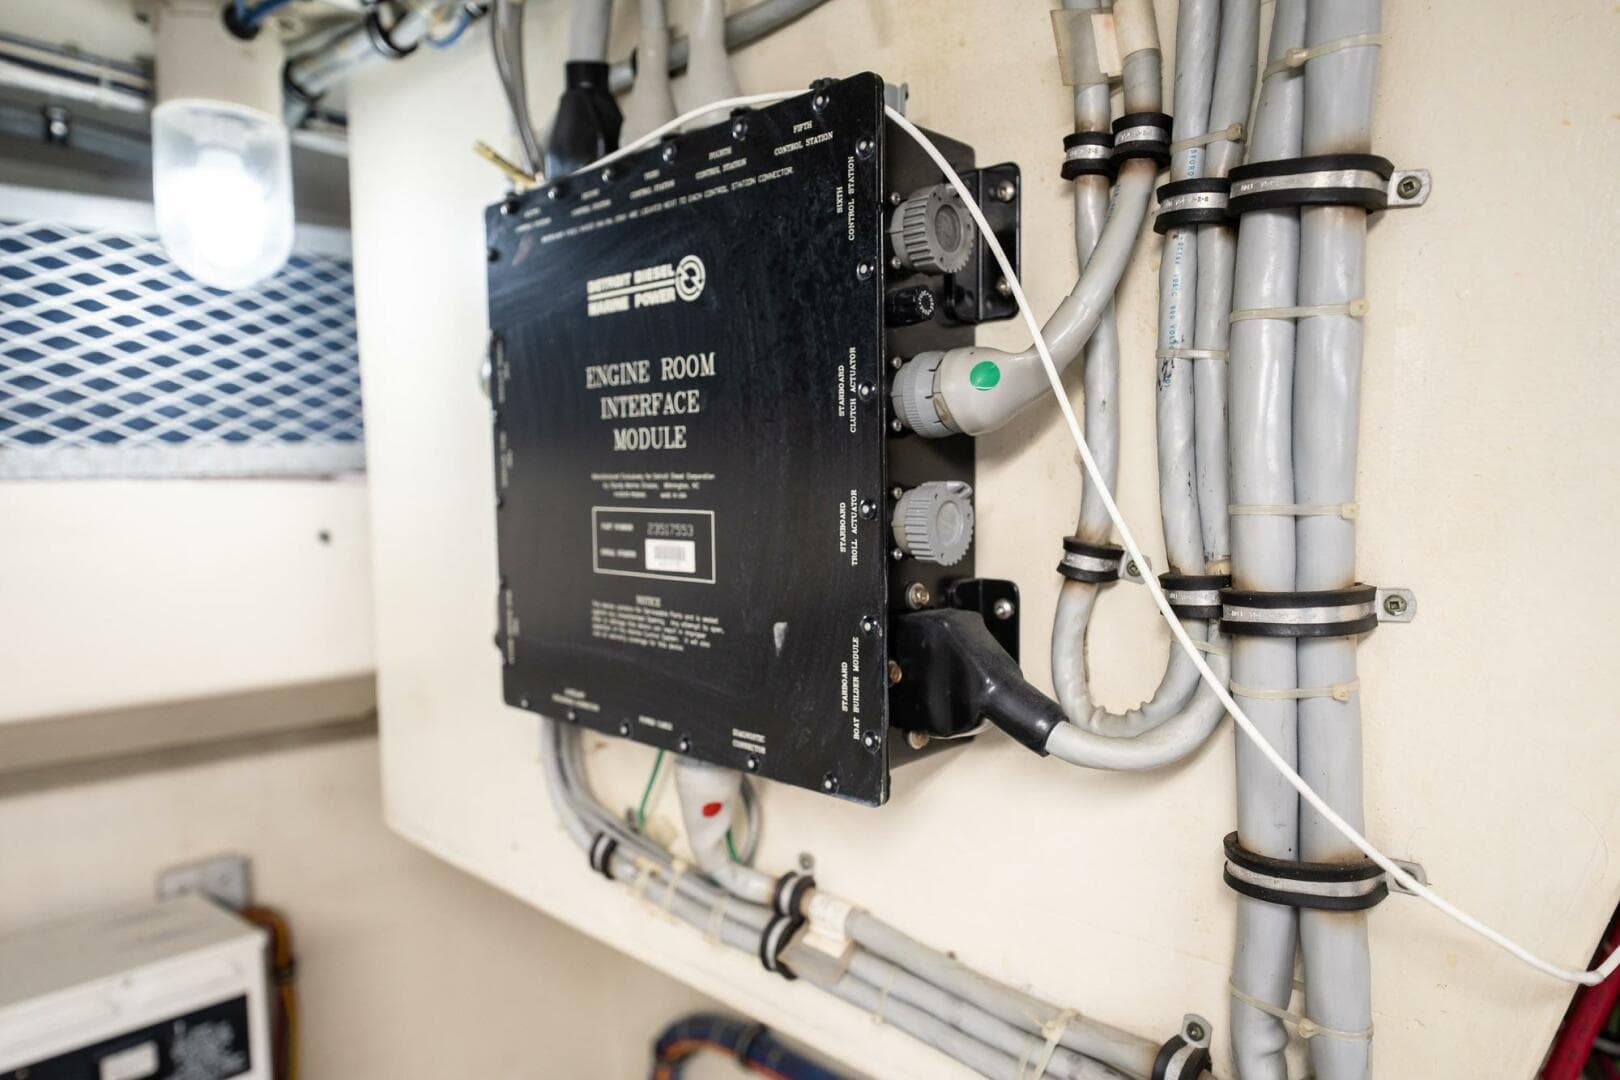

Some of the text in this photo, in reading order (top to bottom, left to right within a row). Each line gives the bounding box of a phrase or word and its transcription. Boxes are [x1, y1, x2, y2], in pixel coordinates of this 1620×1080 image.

[793, 120, 812, 134] FIFTH
[774, 131, 833, 156] CONTROL STATION
[758, 166, 794, 183] CONNECTOR
[585, 352, 716, 389] ENGINE ROOM
[600, 389, 700, 420] INTERFACE
[614, 426, 687, 451] MODULE
[852, 675, 860, 713] BUILDER
